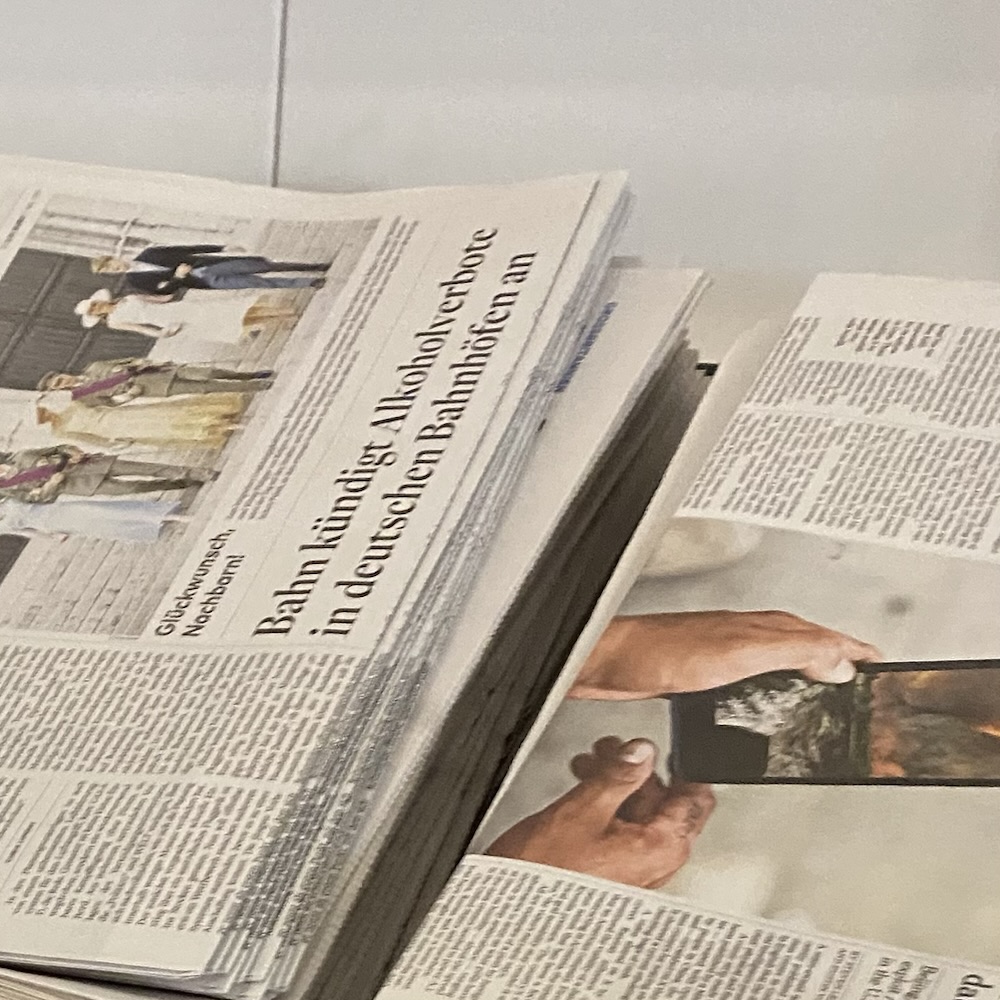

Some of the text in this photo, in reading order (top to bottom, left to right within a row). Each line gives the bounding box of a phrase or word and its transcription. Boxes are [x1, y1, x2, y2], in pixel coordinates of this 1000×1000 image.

[250, 227, 500, 640] Bahn kündigt Alkoholverbote
[310, 250, 538, 638] in deutschen Bahnhöfen an
[152, 527, 235, 638] Glückwunsch,
[179, 552, 247, 638] Nachbarn!
[869, 969, 889, 986] the
[878, 957, 892, 967] in
[887, 960, 913, 994] exploit
